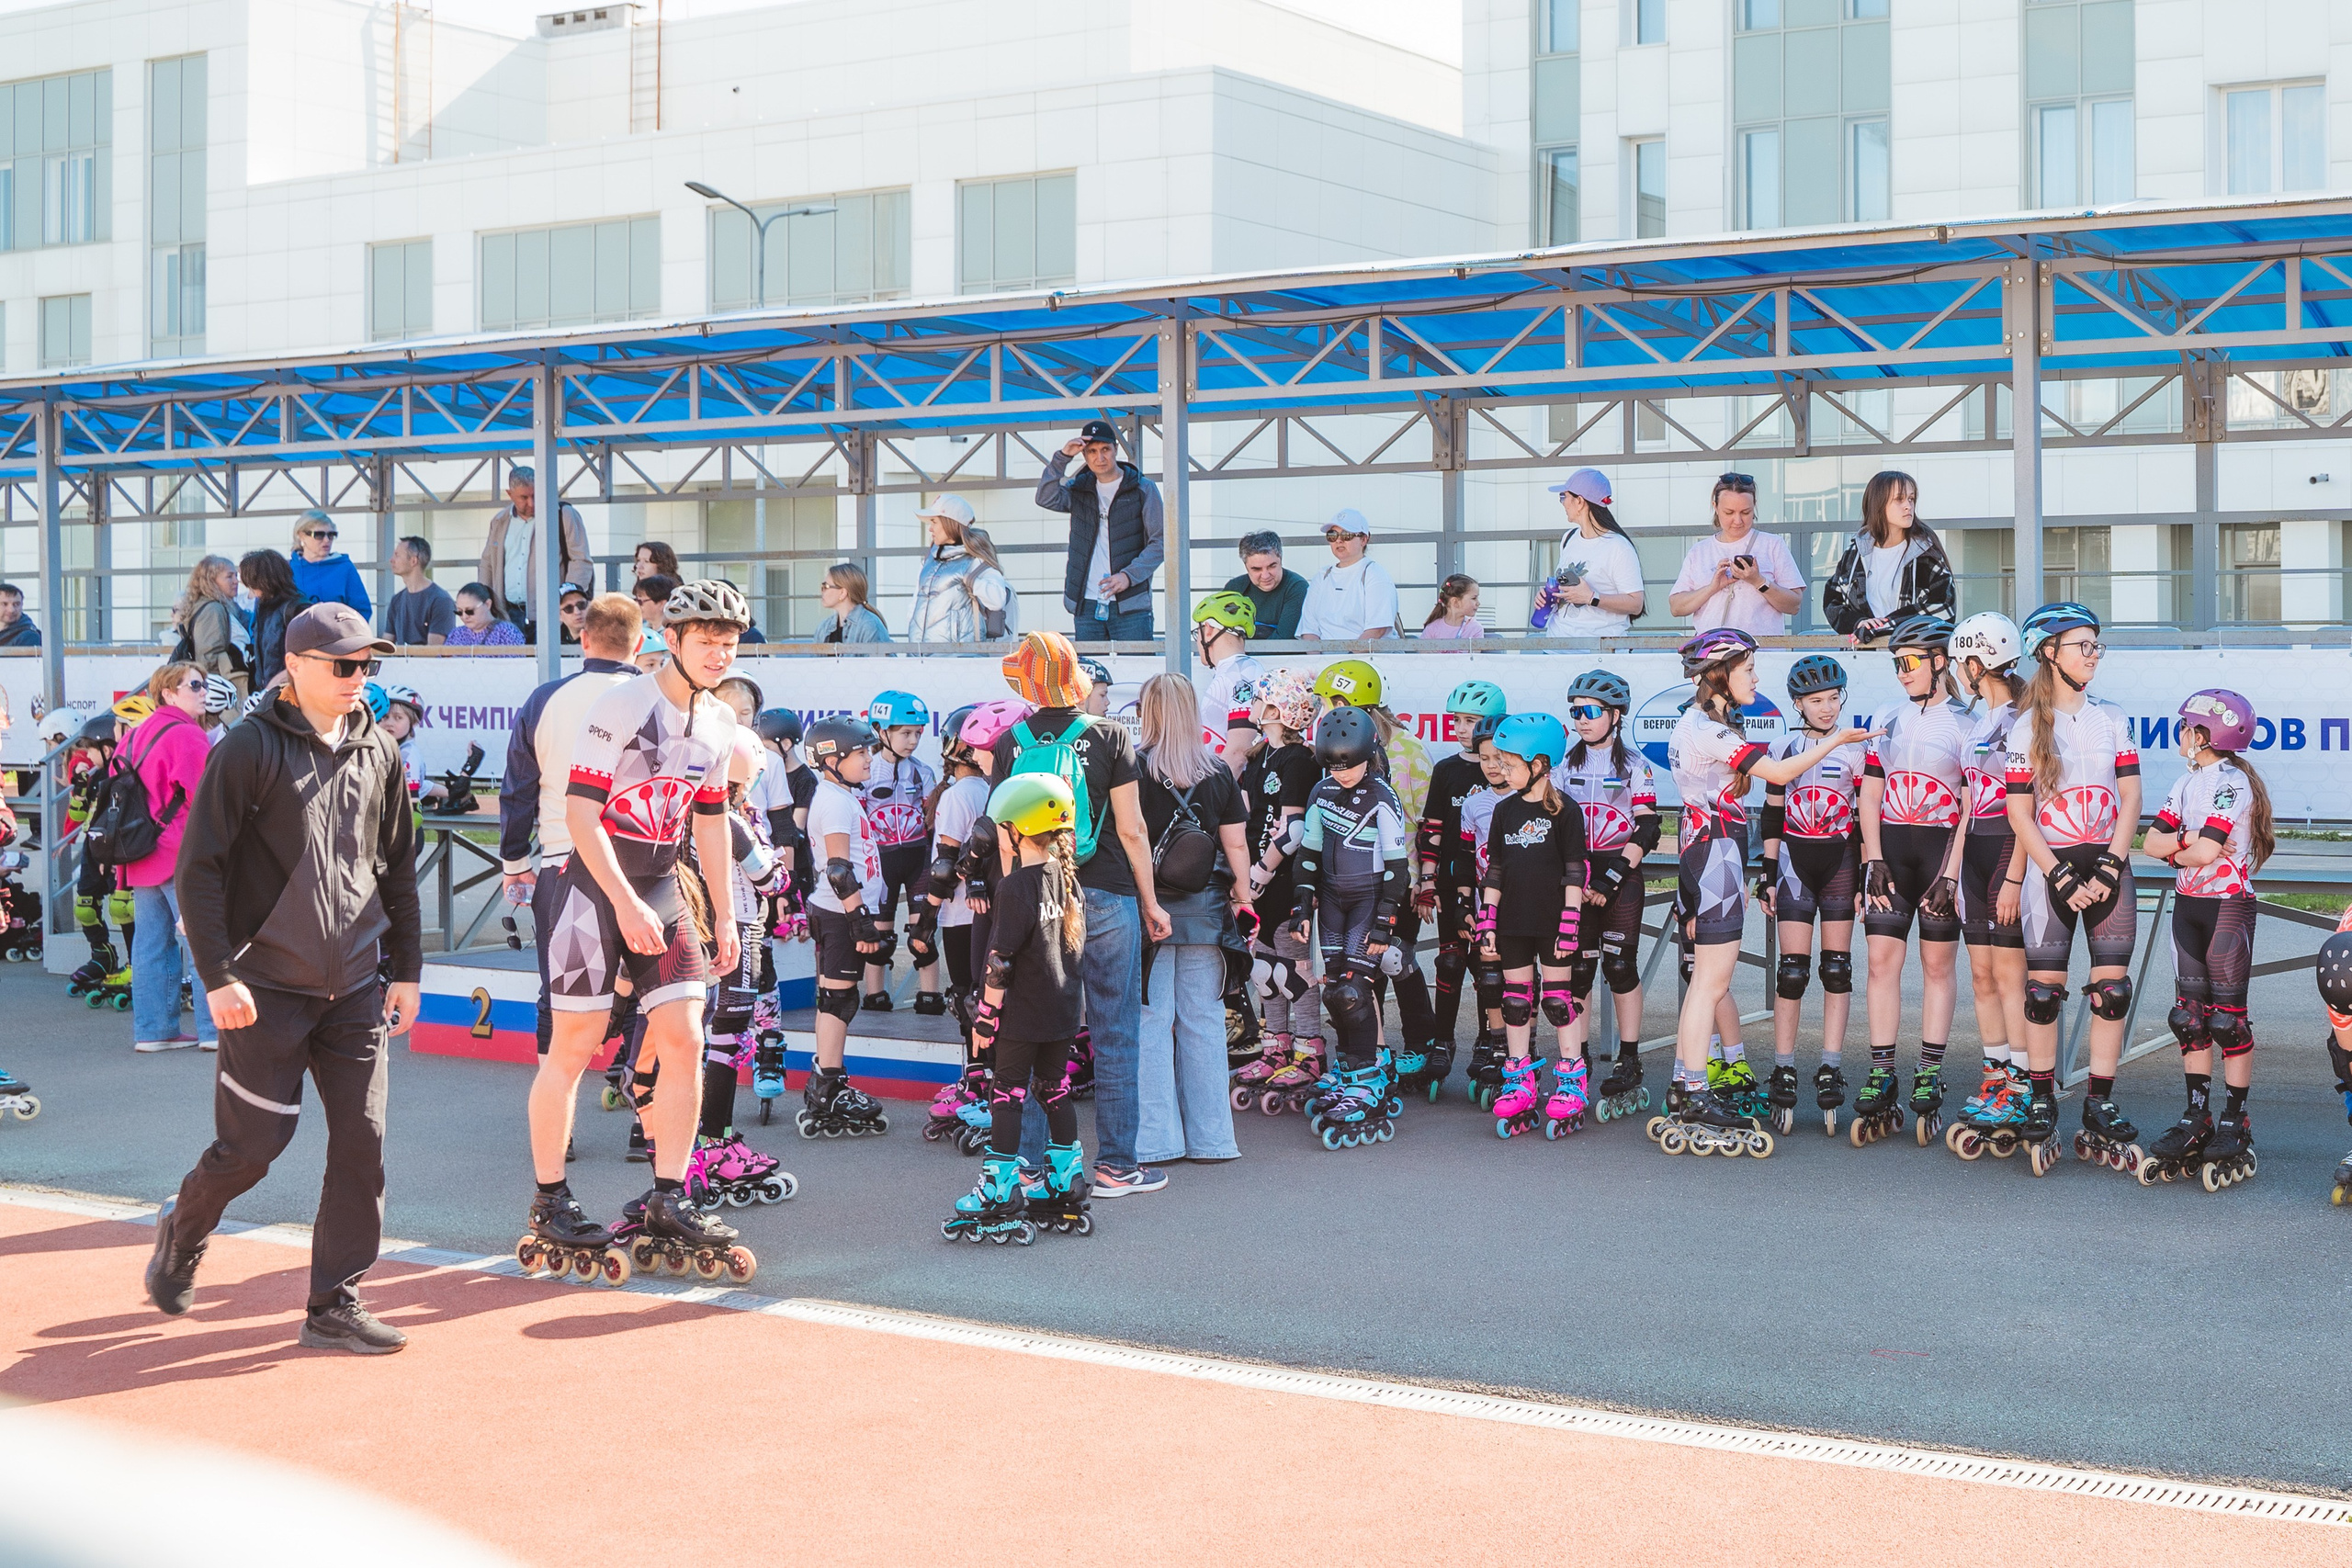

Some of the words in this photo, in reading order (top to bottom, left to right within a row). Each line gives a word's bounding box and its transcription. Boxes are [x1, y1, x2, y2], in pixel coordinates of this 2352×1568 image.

[1954, 637, 1973, 649] 180
[1336, 678, 1351, 689] 57
[66, 700, 96, 710] НСПОРТ
[874, 705, 888, 716] 141
[438, 705, 523, 730] ЧЕМПИ
[1643, 719, 1679, 730] ВСЕРОС
[1746, 718, 1775, 730] РАЦИЯ
[588, 724, 614, 742] ФРСРБ
[1535, 818, 1551, 829] Me
[470, 987, 493, 1040] 2
[976, 1219, 1023, 1235] Rollerblade
